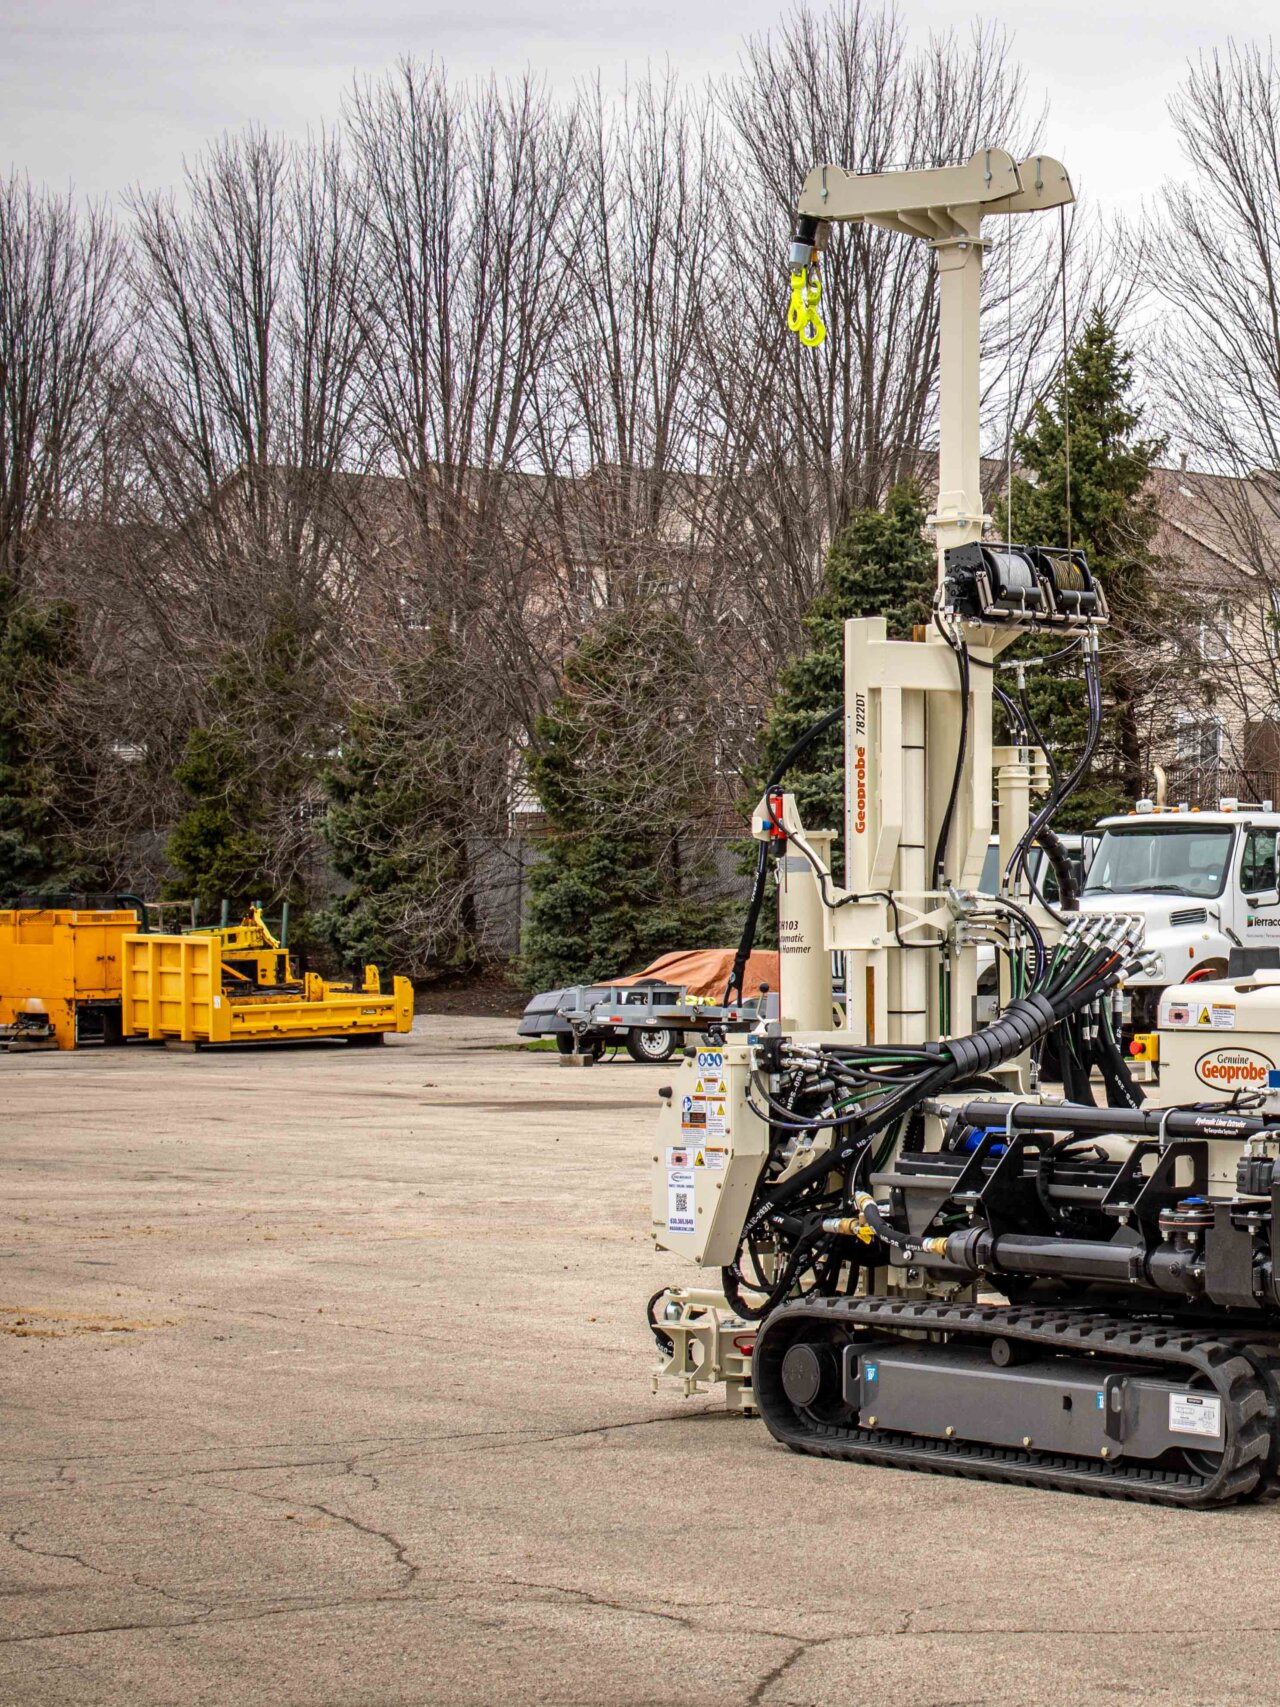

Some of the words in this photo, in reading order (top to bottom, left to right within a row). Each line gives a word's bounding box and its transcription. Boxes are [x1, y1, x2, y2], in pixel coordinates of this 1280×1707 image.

[856, 693, 865, 735] 7822DT
[855, 747, 866, 833] Geoprobe
[1202, 1060, 1266, 1084] Geoprobe
[1217, 1053, 1249, 1065] Genuine
